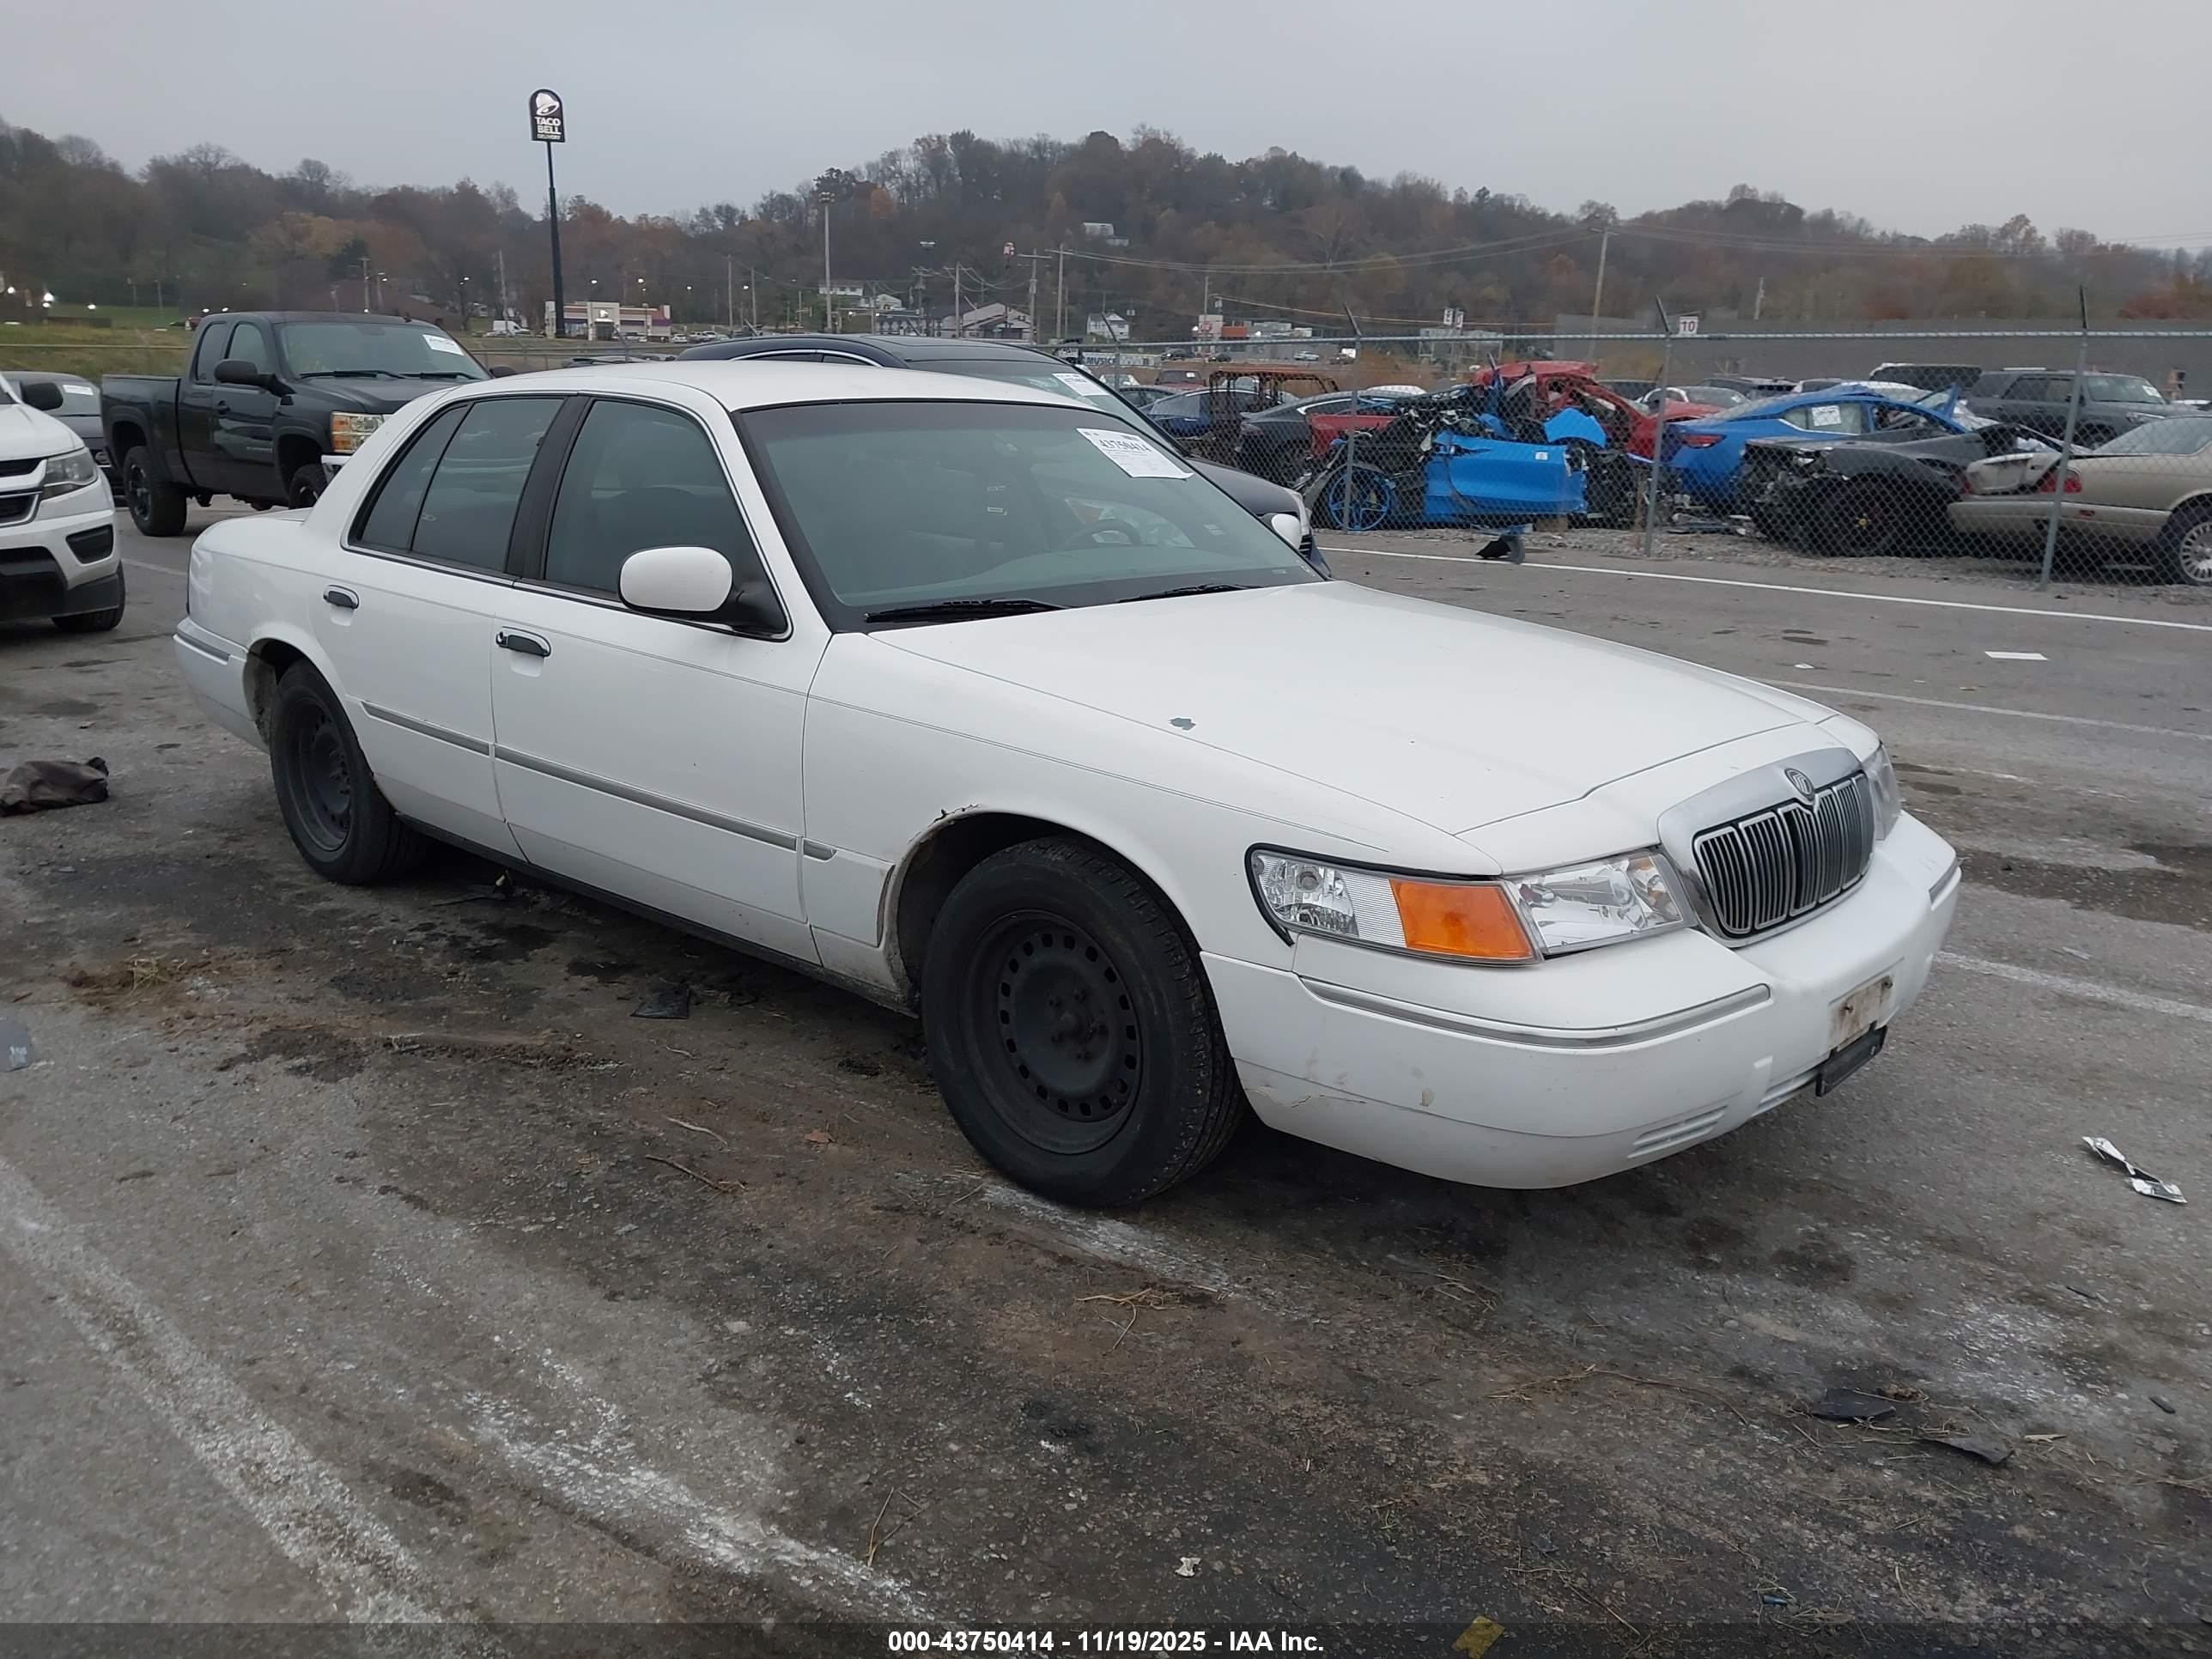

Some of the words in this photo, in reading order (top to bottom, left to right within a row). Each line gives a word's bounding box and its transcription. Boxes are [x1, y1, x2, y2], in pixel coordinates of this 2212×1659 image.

[535, 117, 561, 126] TACO
[537, 125, 562, 135] BELL
[1681, 320, 1696, 331] 10
